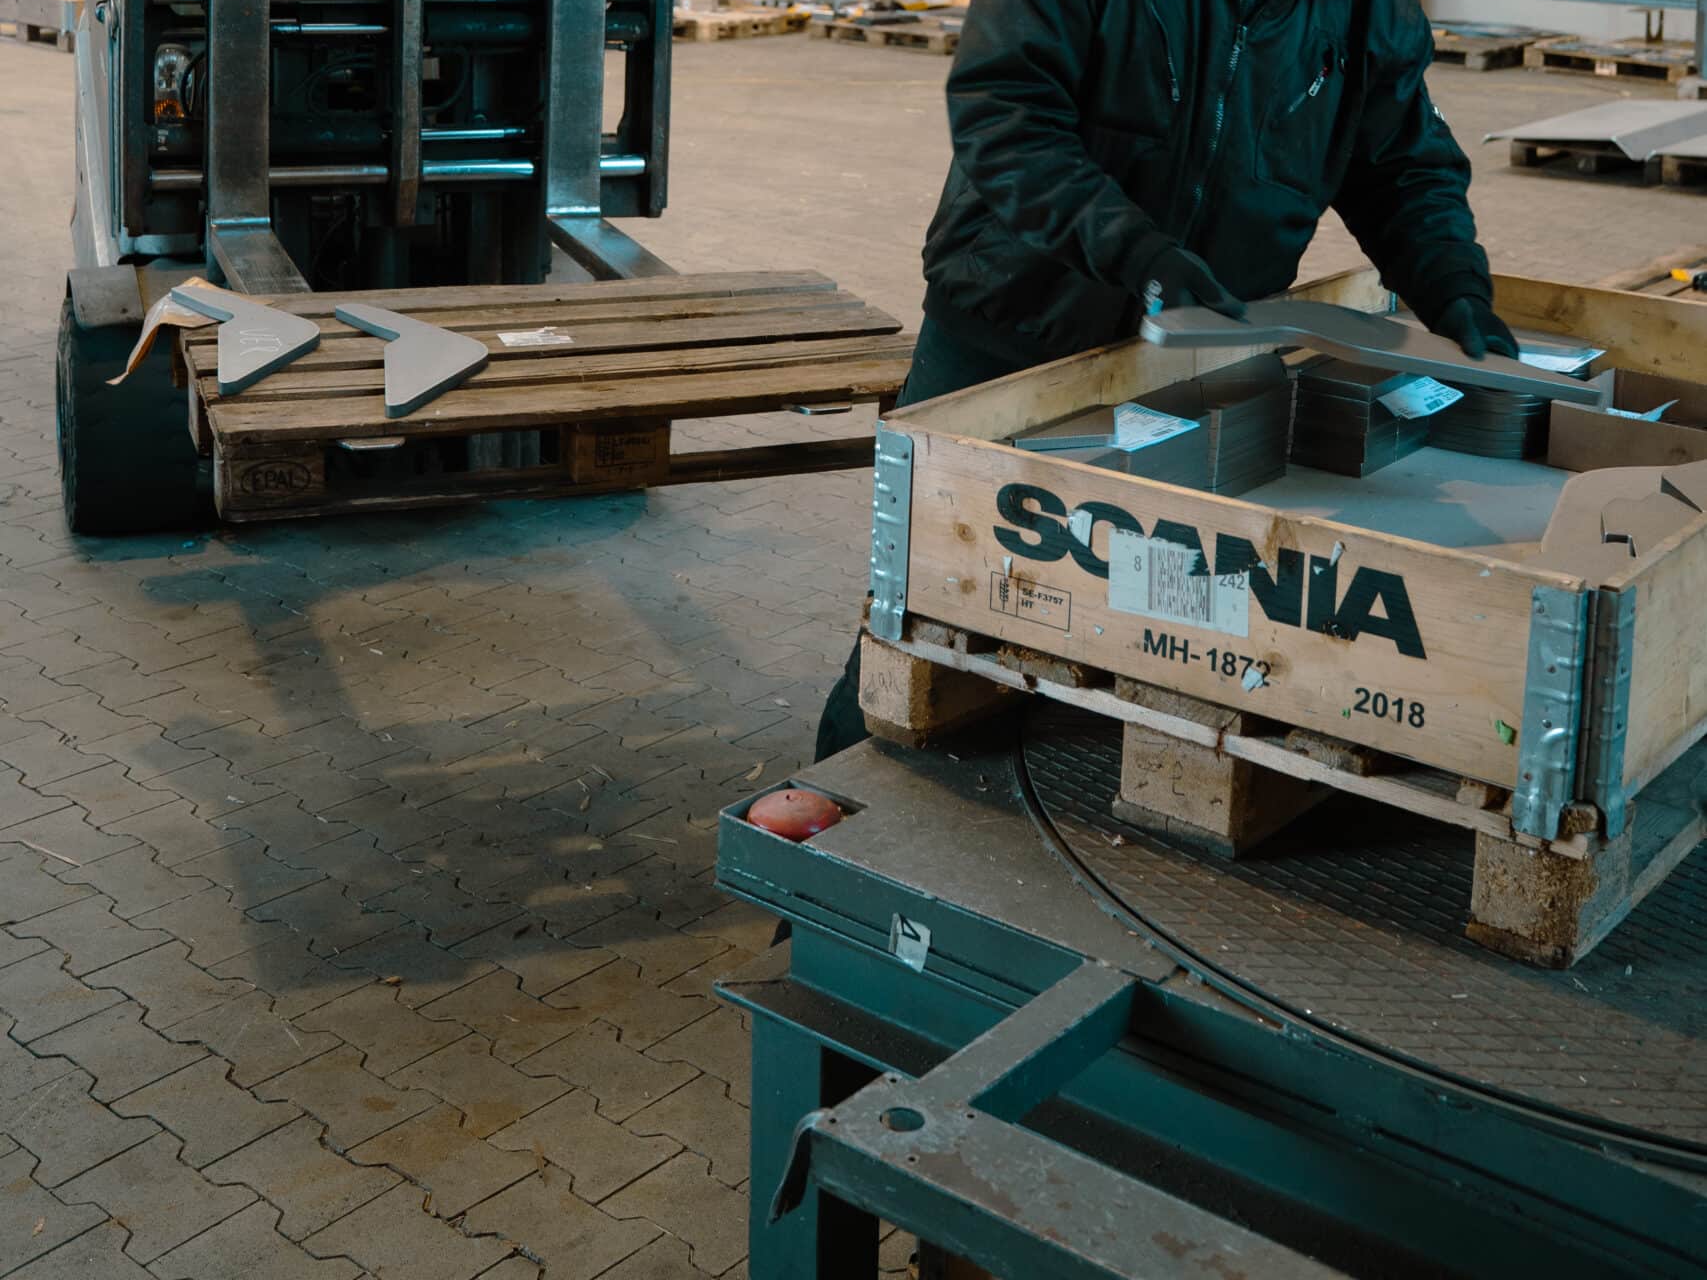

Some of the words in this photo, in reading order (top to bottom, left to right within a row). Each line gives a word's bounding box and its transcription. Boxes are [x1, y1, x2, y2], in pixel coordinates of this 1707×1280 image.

[1133, 555, 1142, 572] 8
[1218, 574, 1246, 591] 242
[1143, 627, 1272, 692] MH-1872
[1353, 687, 1425, 729] 2018
